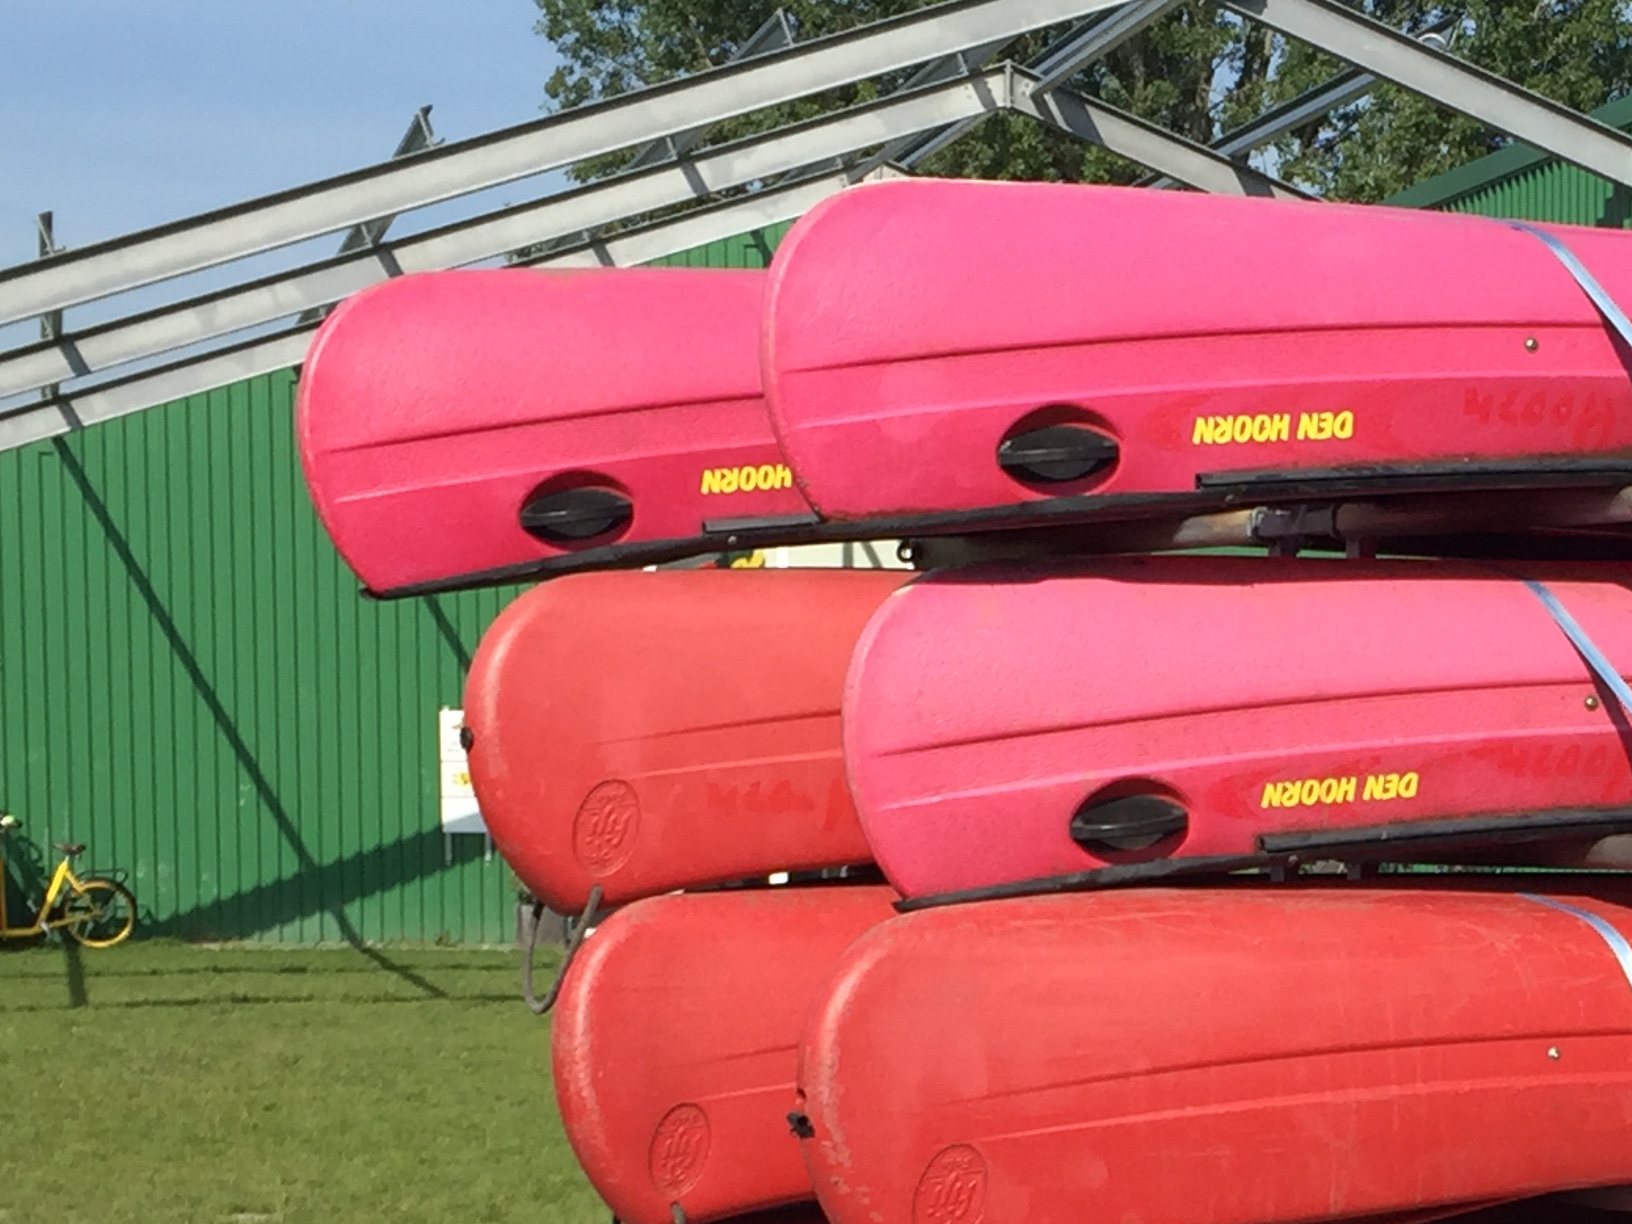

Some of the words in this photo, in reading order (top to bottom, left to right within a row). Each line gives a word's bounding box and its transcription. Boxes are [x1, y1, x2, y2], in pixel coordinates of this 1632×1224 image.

[1192, 413, 1291, 444] HOORN
[1295, 410, 1355, 441] DEN
[700, 464, 793, 494] HOORN
[1260, 776, 1358, 808] HOORN
[1361, 771, 1419, 801] DEN
